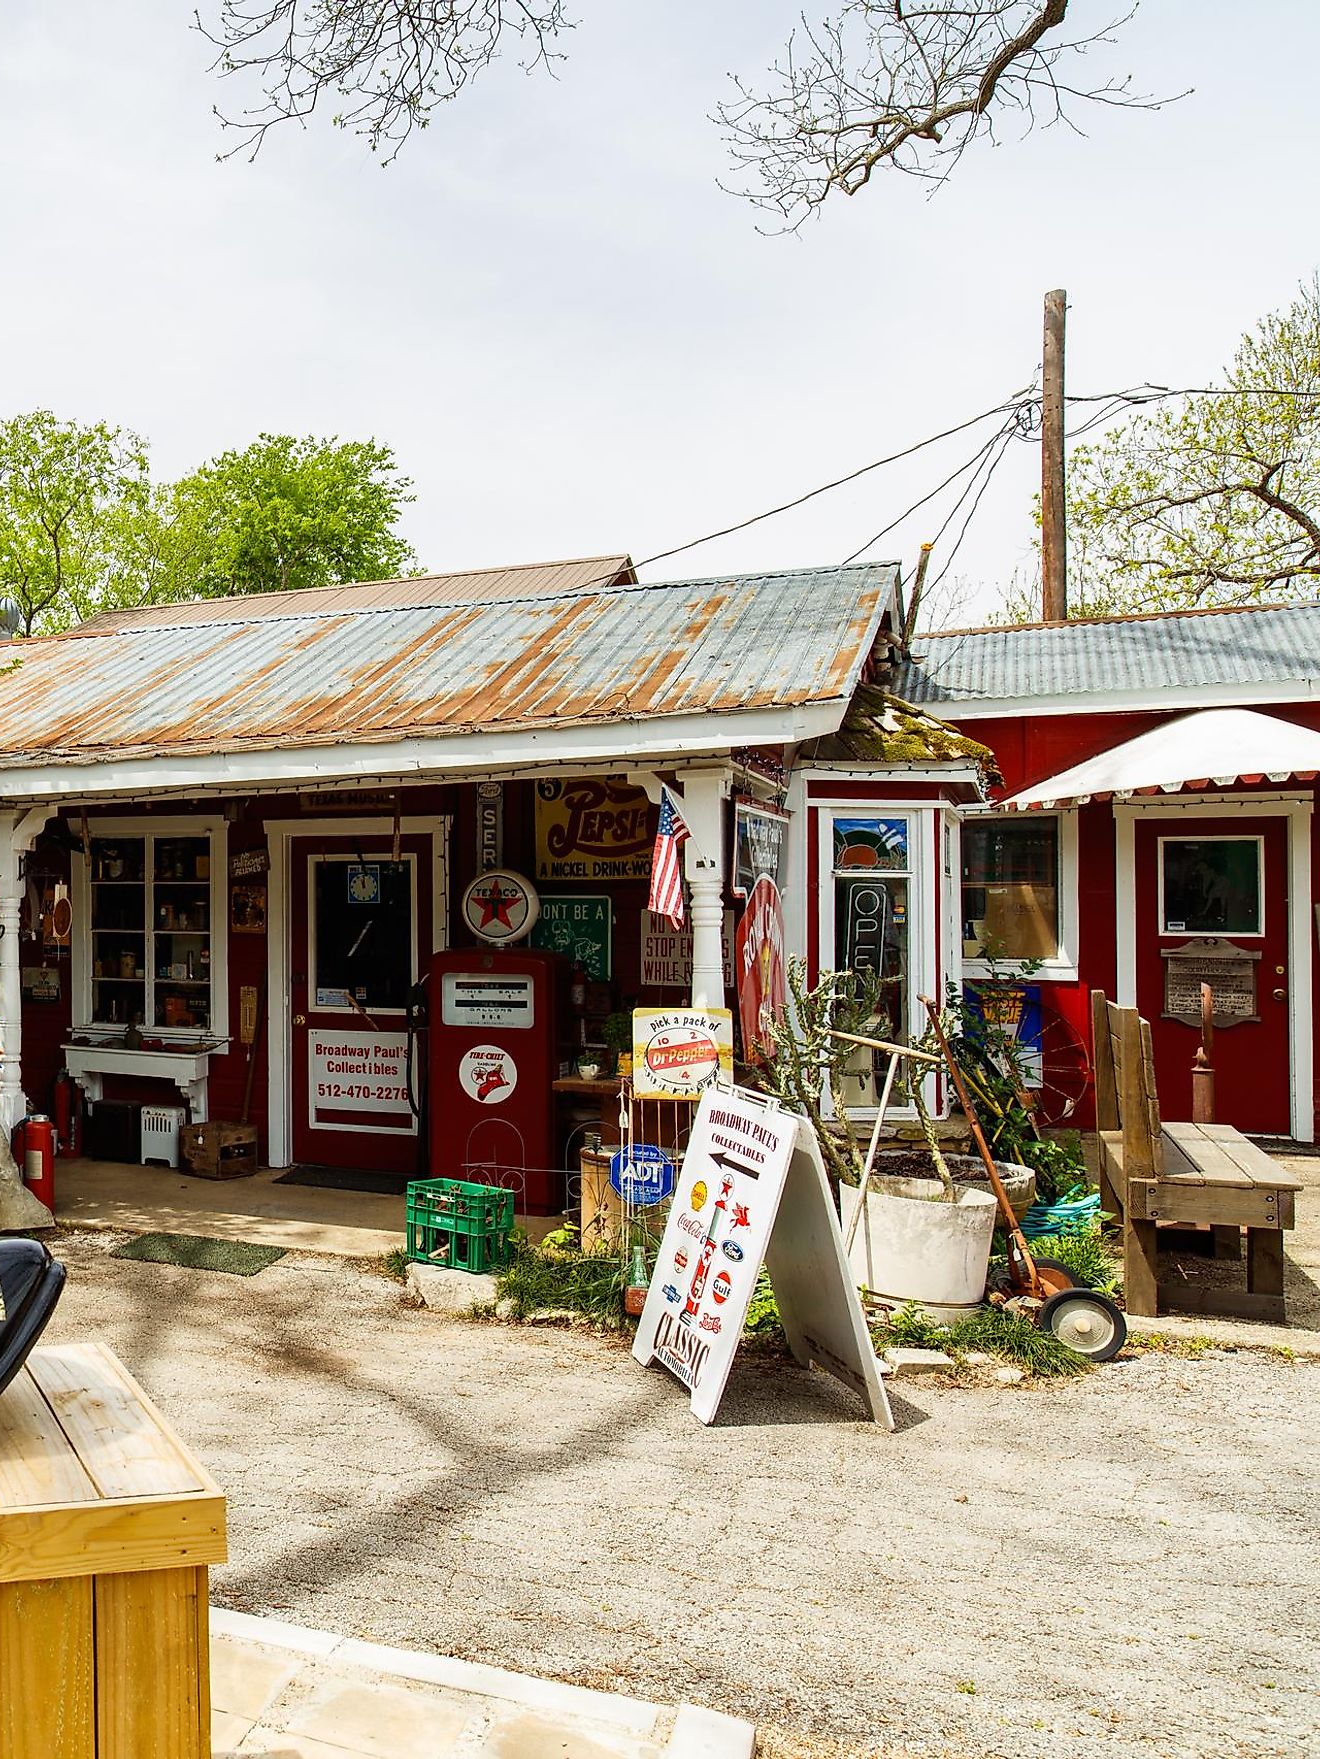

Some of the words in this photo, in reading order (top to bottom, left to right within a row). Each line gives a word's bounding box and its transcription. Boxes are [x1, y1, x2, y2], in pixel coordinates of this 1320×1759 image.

[483, 809, 496, 870] SER
[540, 862, 548, 876] A
[552, 861, 588, 876] NICKEL
[476, 888, 518, 899] TEXACO
[574, 903, 589, 919] BE
[596, 904, 604, 919] A
[646, 938, 675, 957] STOP
[643, 962, 679, 982] WHILE
[650, 1016, 670, 1032] pick
[674, 1016, 679, 1024] a
[683, 1016, 706, 1026] pack
[709, 1022, 722, 1031] of
[657, 1037, 669, 1045] 10
[690, 1031, 697, 1039] 2
[315, 1043, 370, 1059] Broadway
[374, 1045, 409, 1058] Paul's
[327, 1060, 398, 1075] Collectibles
[681, 1071, 690, 1079] 4
[318, 1083, 409, 1101] 512-470-2276
[709, 1110, 753, 1135] BROADWAY
[752, 1123, 779, 1152] PAUL'S
[712, 1133, 766, 1164] COLLECTABLES
[620, 1161, 660, 1183] ADT
[724, 1242, 742, 1260] Ford
[713, 1279, 732, 1298] Gulf
[653, 1311, 711, 1389] CLASSIC
